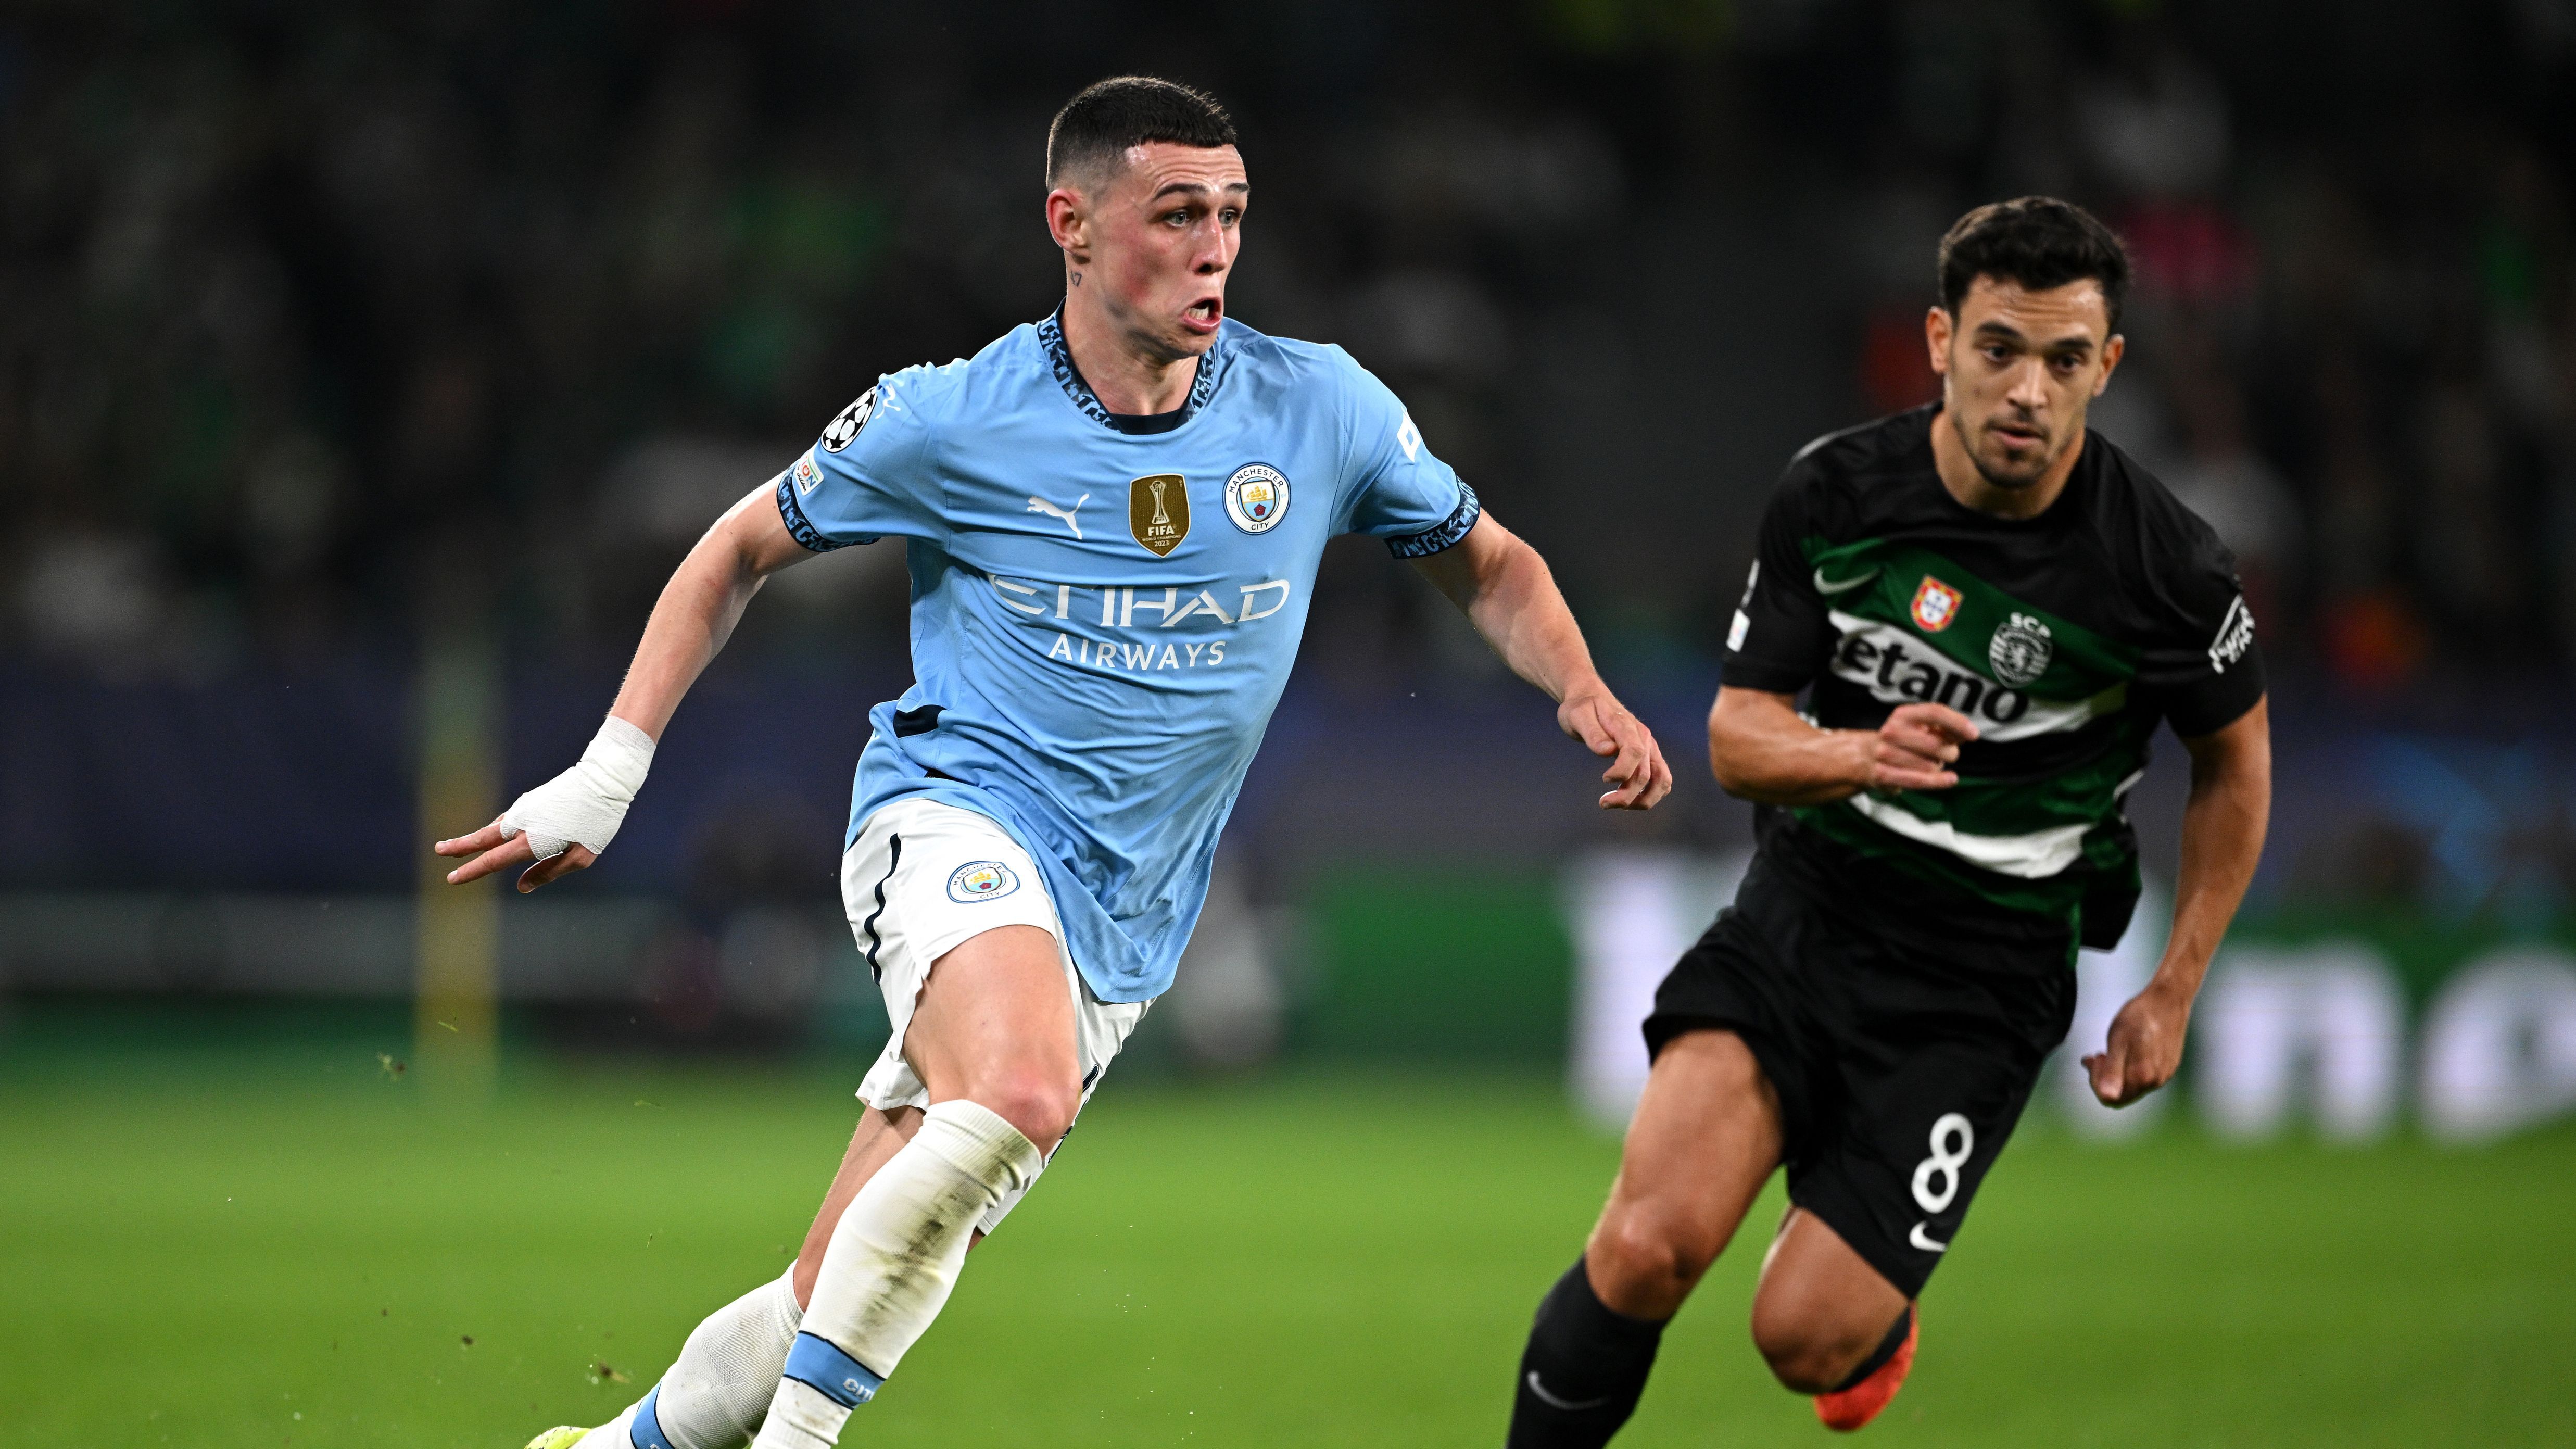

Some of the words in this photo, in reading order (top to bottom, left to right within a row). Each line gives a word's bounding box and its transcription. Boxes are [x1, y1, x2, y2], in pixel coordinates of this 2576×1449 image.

[1229, 468, 1284, 493] MANCHESTER
[1148, 525, 1175, 536] FIFA
[1251, 522, 1269, 531] CITY
[989, 573, 1290, 627] ETIHAD
[1047, 633, 1226, 671] AIRWAYS
[1838, 638, 2029, 723] etano
[953, 863, 1007, 886] MANCHESTER
[1911, 1112, 1974, 1214] 8
